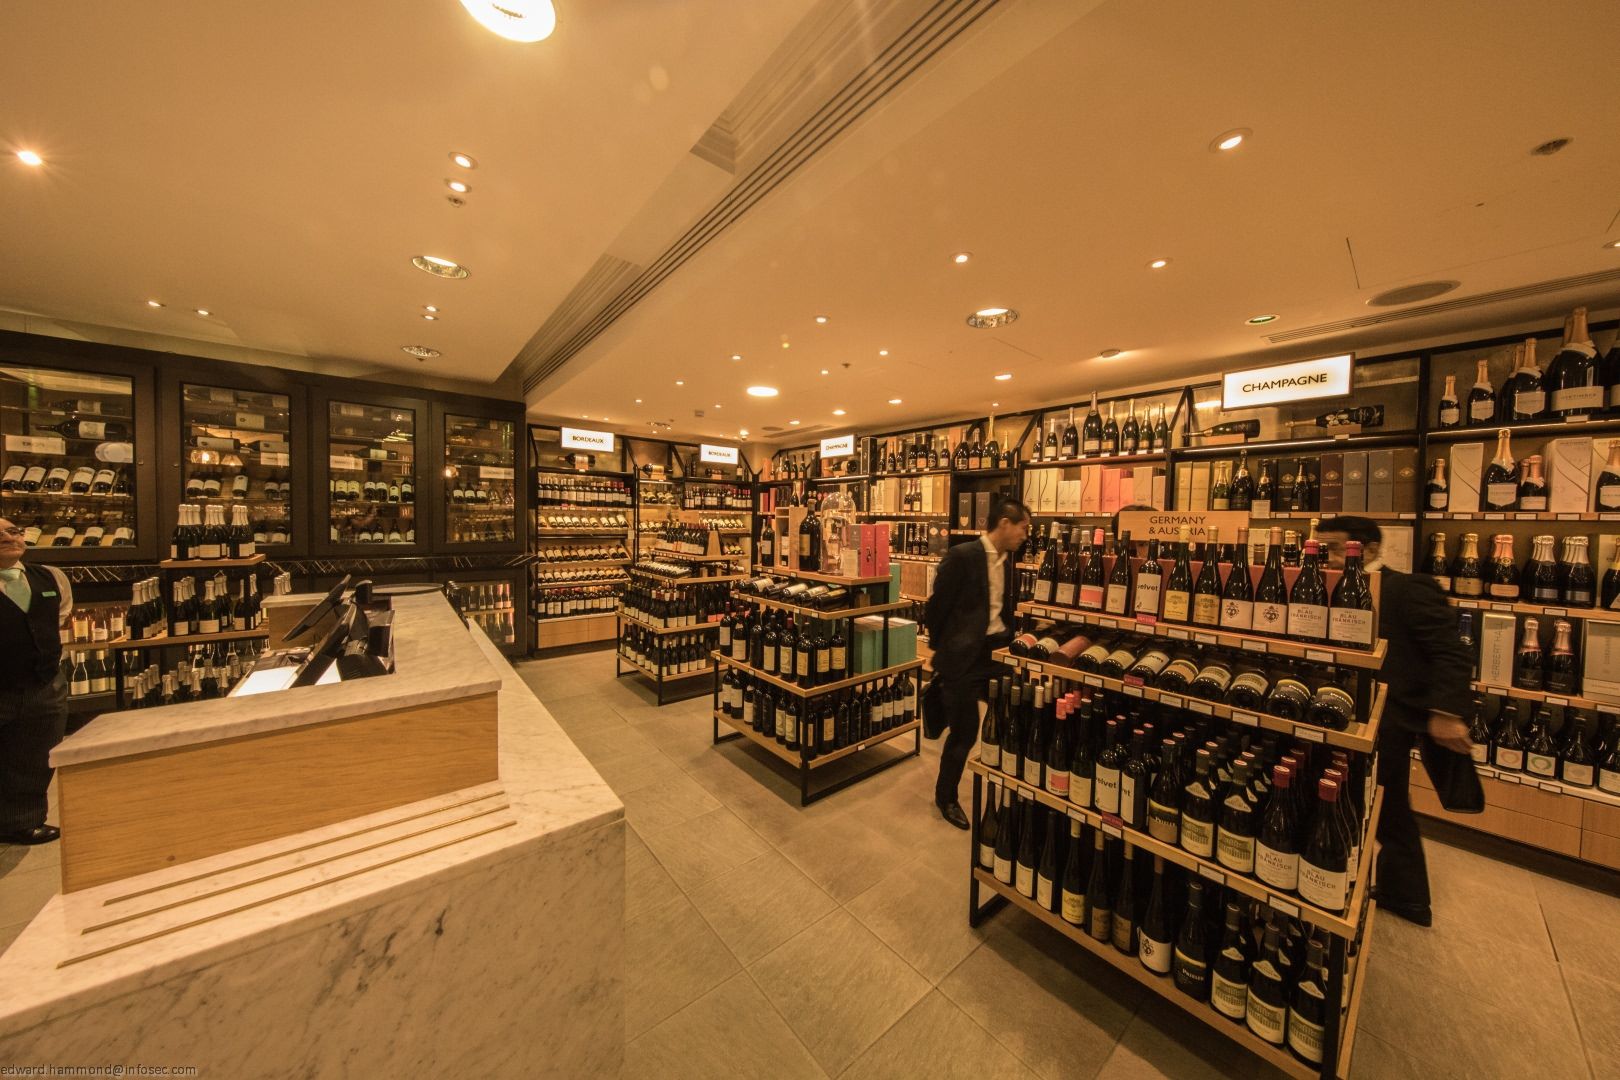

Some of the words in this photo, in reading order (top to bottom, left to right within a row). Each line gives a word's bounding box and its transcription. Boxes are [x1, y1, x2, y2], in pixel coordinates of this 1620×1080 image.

[1242, 373, 1328, 393] CHAMPAGNE
[572, 435, 604, 444] BORDEAUX
[1150, 515, 1206, 525] GERMANY
[1149, 526, 1156, 535] &
[1157, 526, 1206, 536] AUSRIA
[1097, 777, 1118, 789] elvet
[1265, 852, 1283, 863] BLAU
[1306, 868, 1325, 881] BLAU
